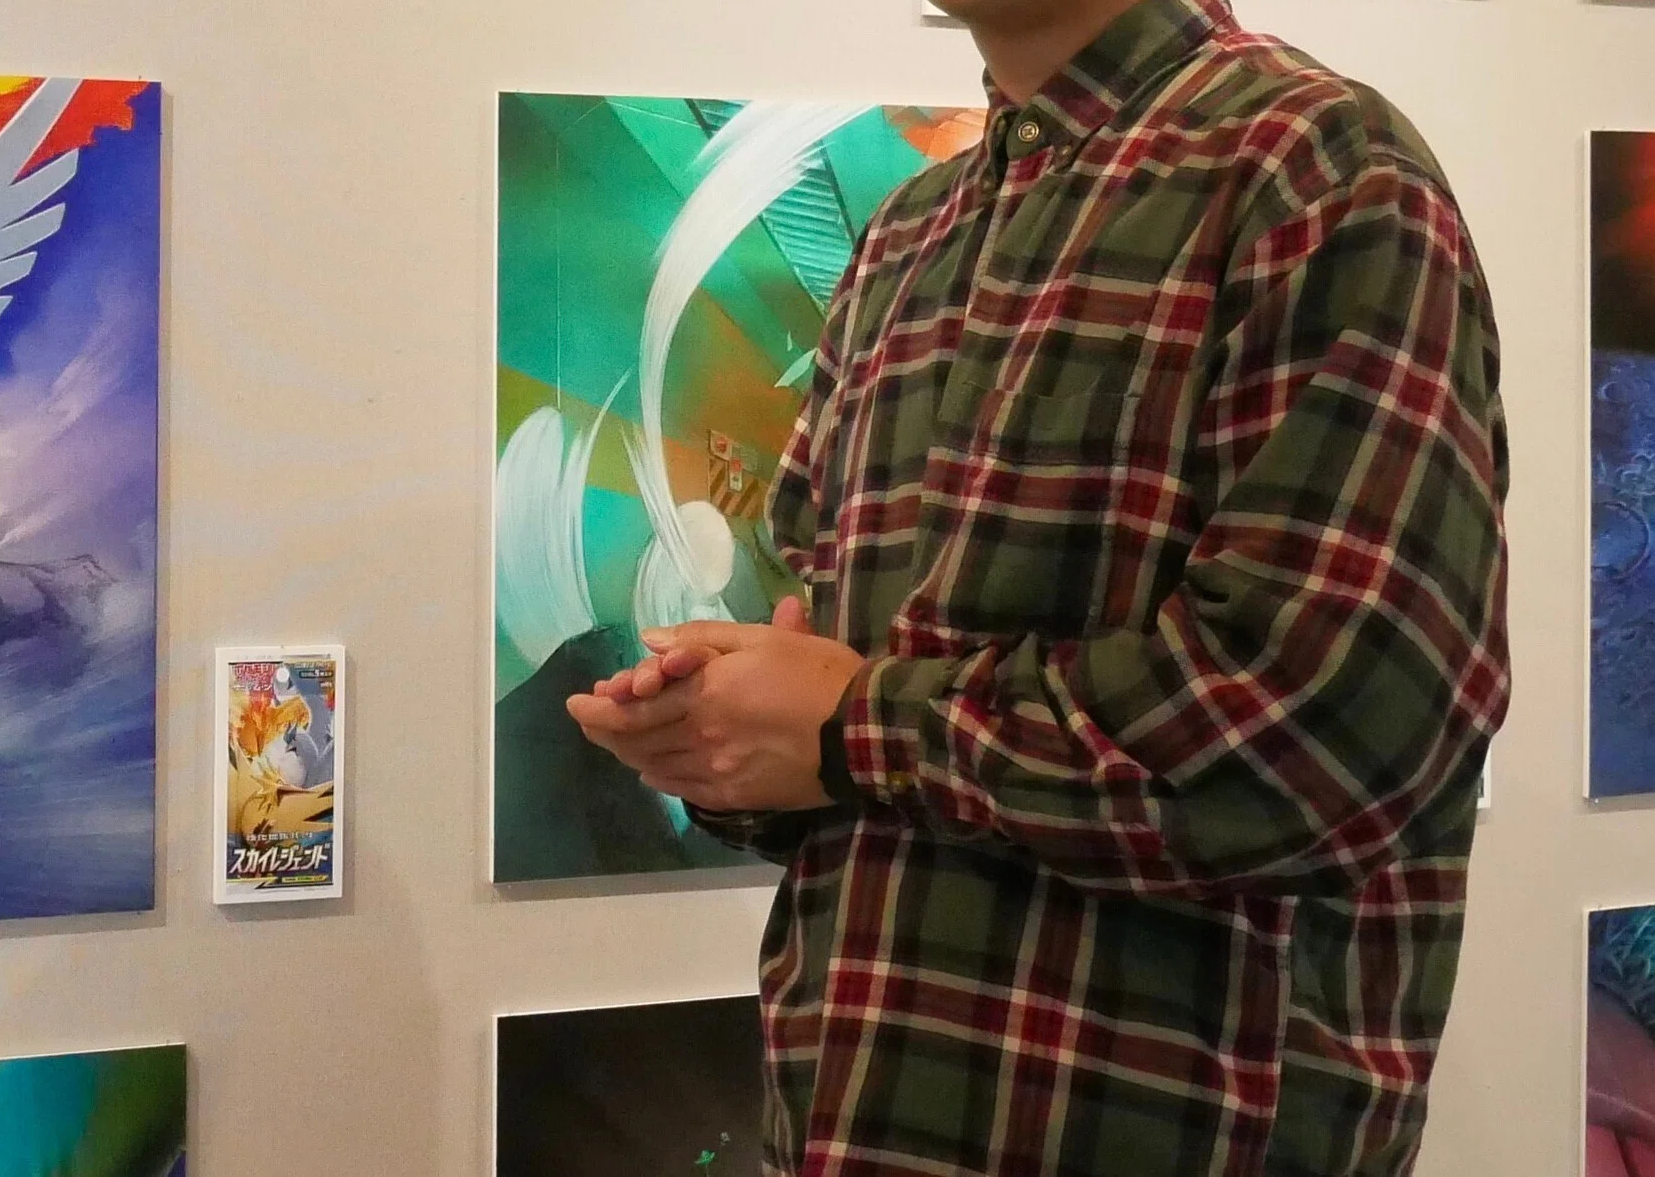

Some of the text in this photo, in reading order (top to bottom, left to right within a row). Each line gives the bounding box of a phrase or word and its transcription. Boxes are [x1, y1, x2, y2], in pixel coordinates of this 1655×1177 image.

[229, 843, 330, 874] スカイレジェンド
